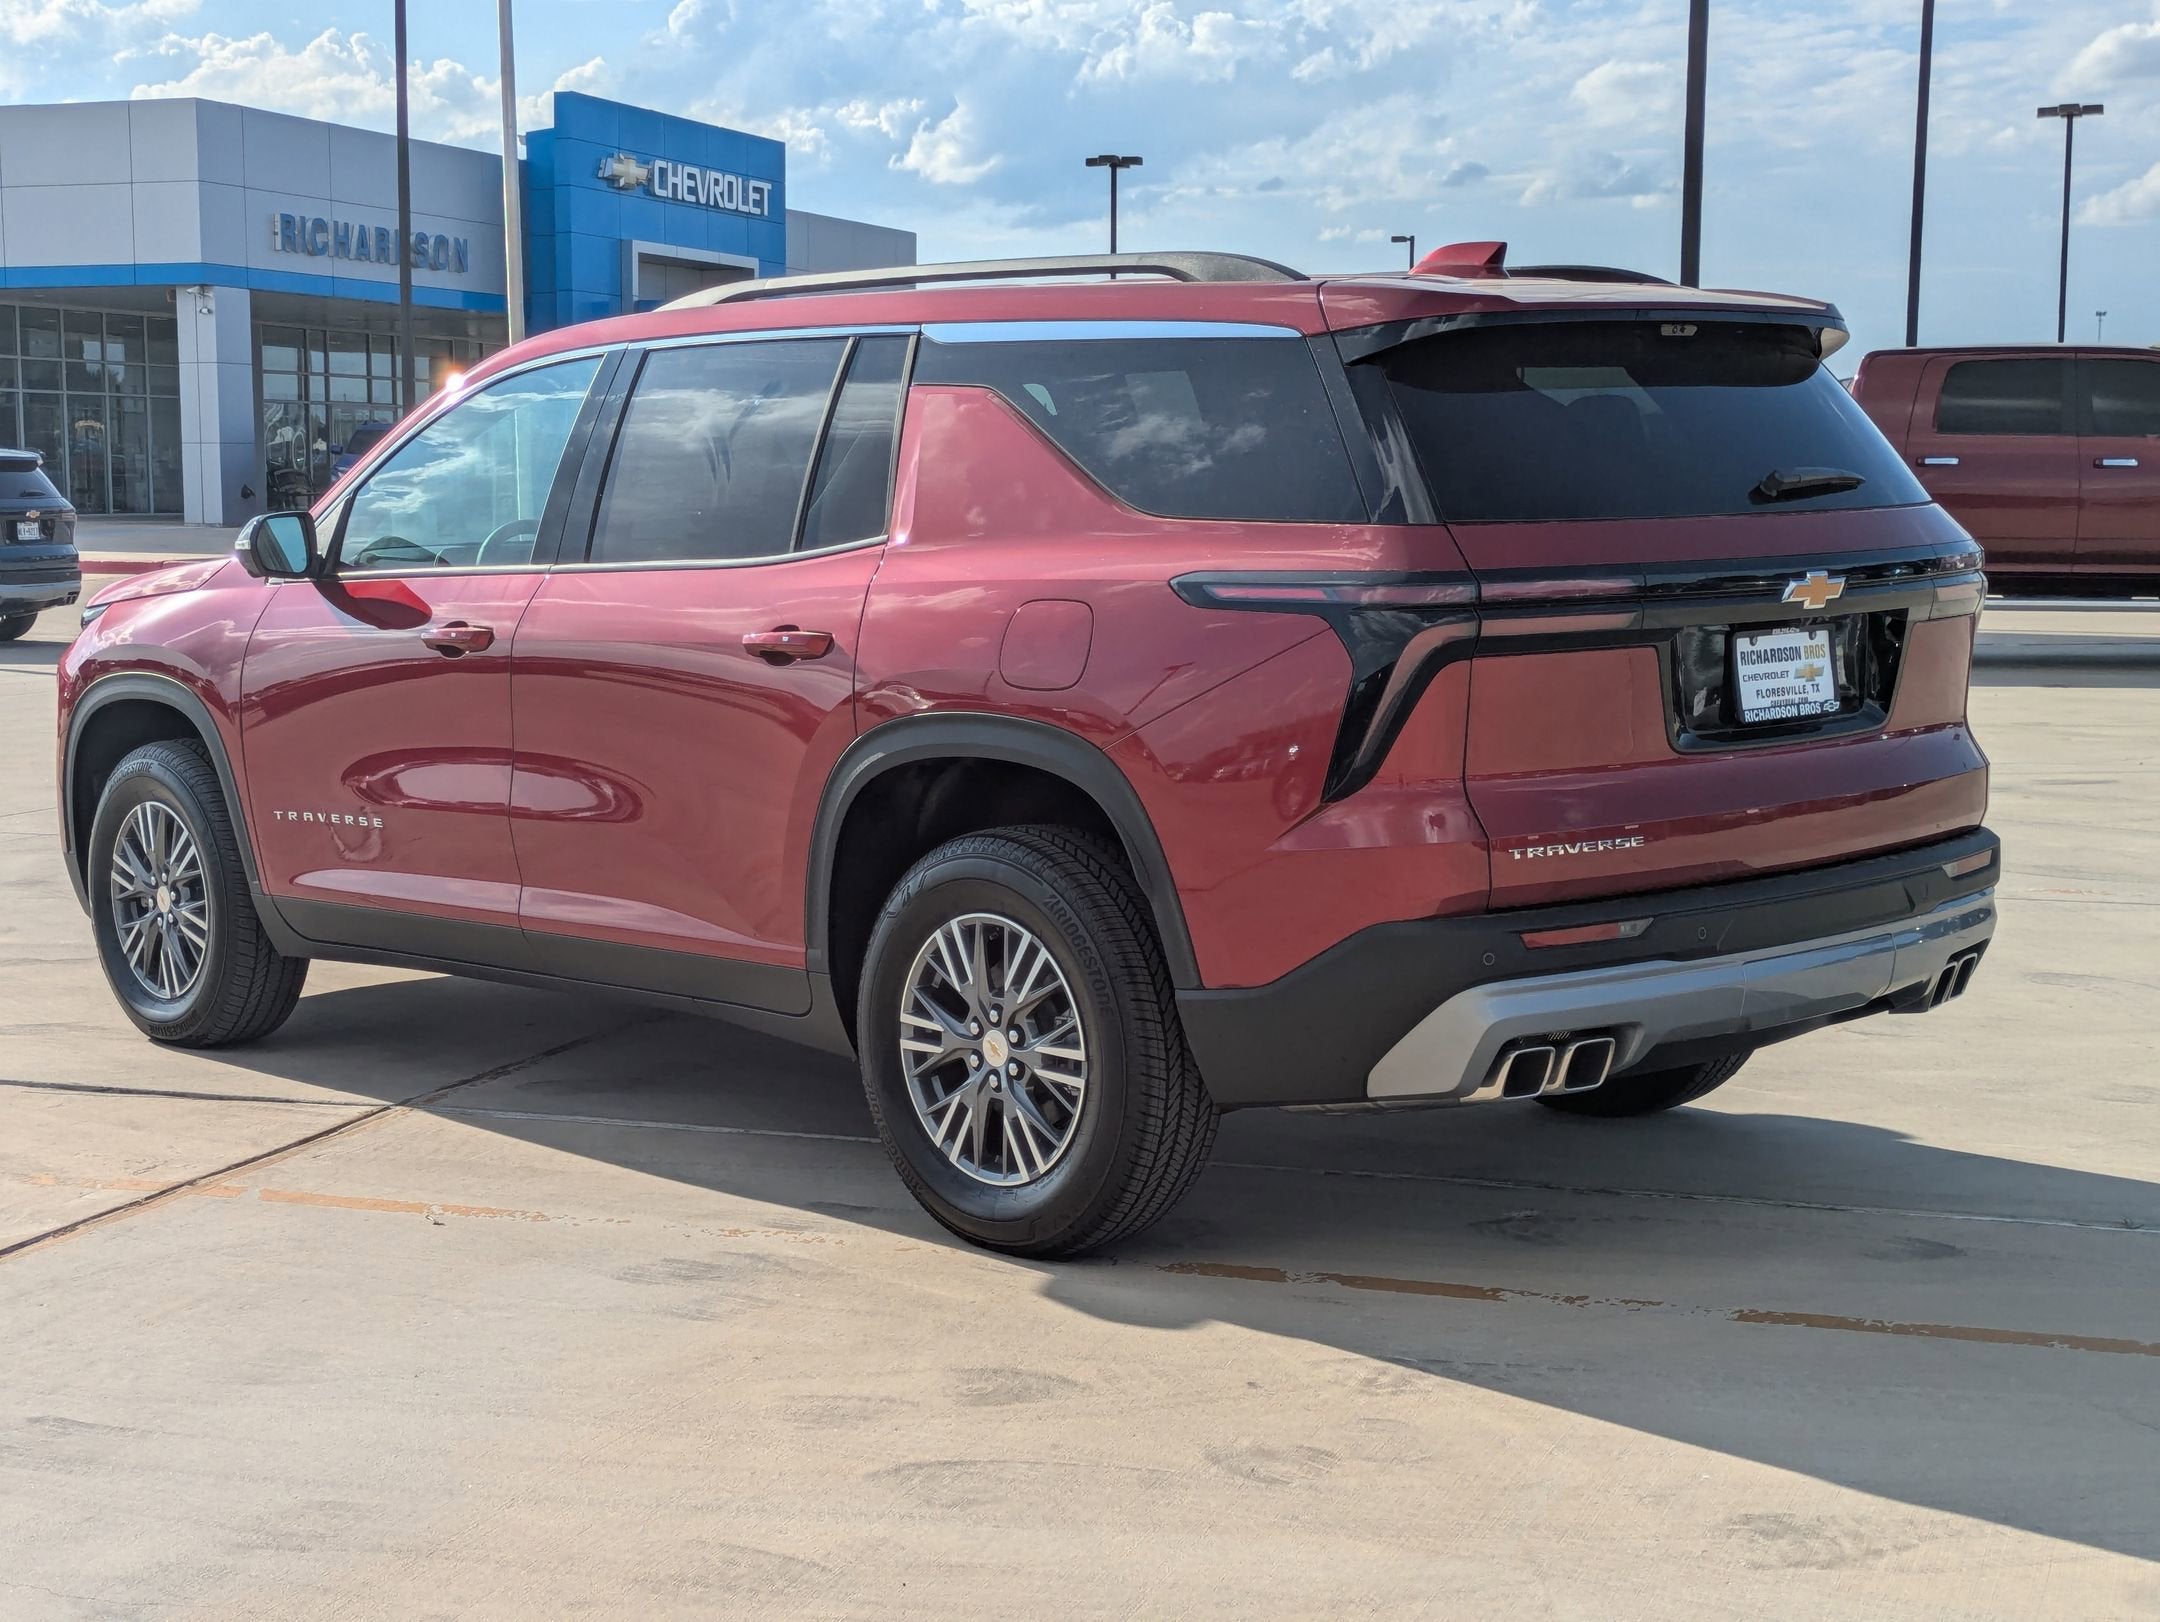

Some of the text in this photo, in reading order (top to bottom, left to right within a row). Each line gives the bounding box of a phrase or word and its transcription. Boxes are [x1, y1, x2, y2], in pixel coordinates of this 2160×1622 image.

[653, 159, 772, 217] CHEVROLET
[274, 213, 469, 273] RICHARSON
[1740, 643, 1826, 667] RICHARDSON BROS
[1742, 670, 1790, 682] CHEVROLET
[1756, 683, 1820, 699] FLORESVILLE, TX
[1744, 704, 1798, 722] RICHARDSON
[1800, 702, 1821, 715] BROS
[273, 810, 383, 828] TRAVERSE
[1508, 836, 1645, 860] TRAVERSE
